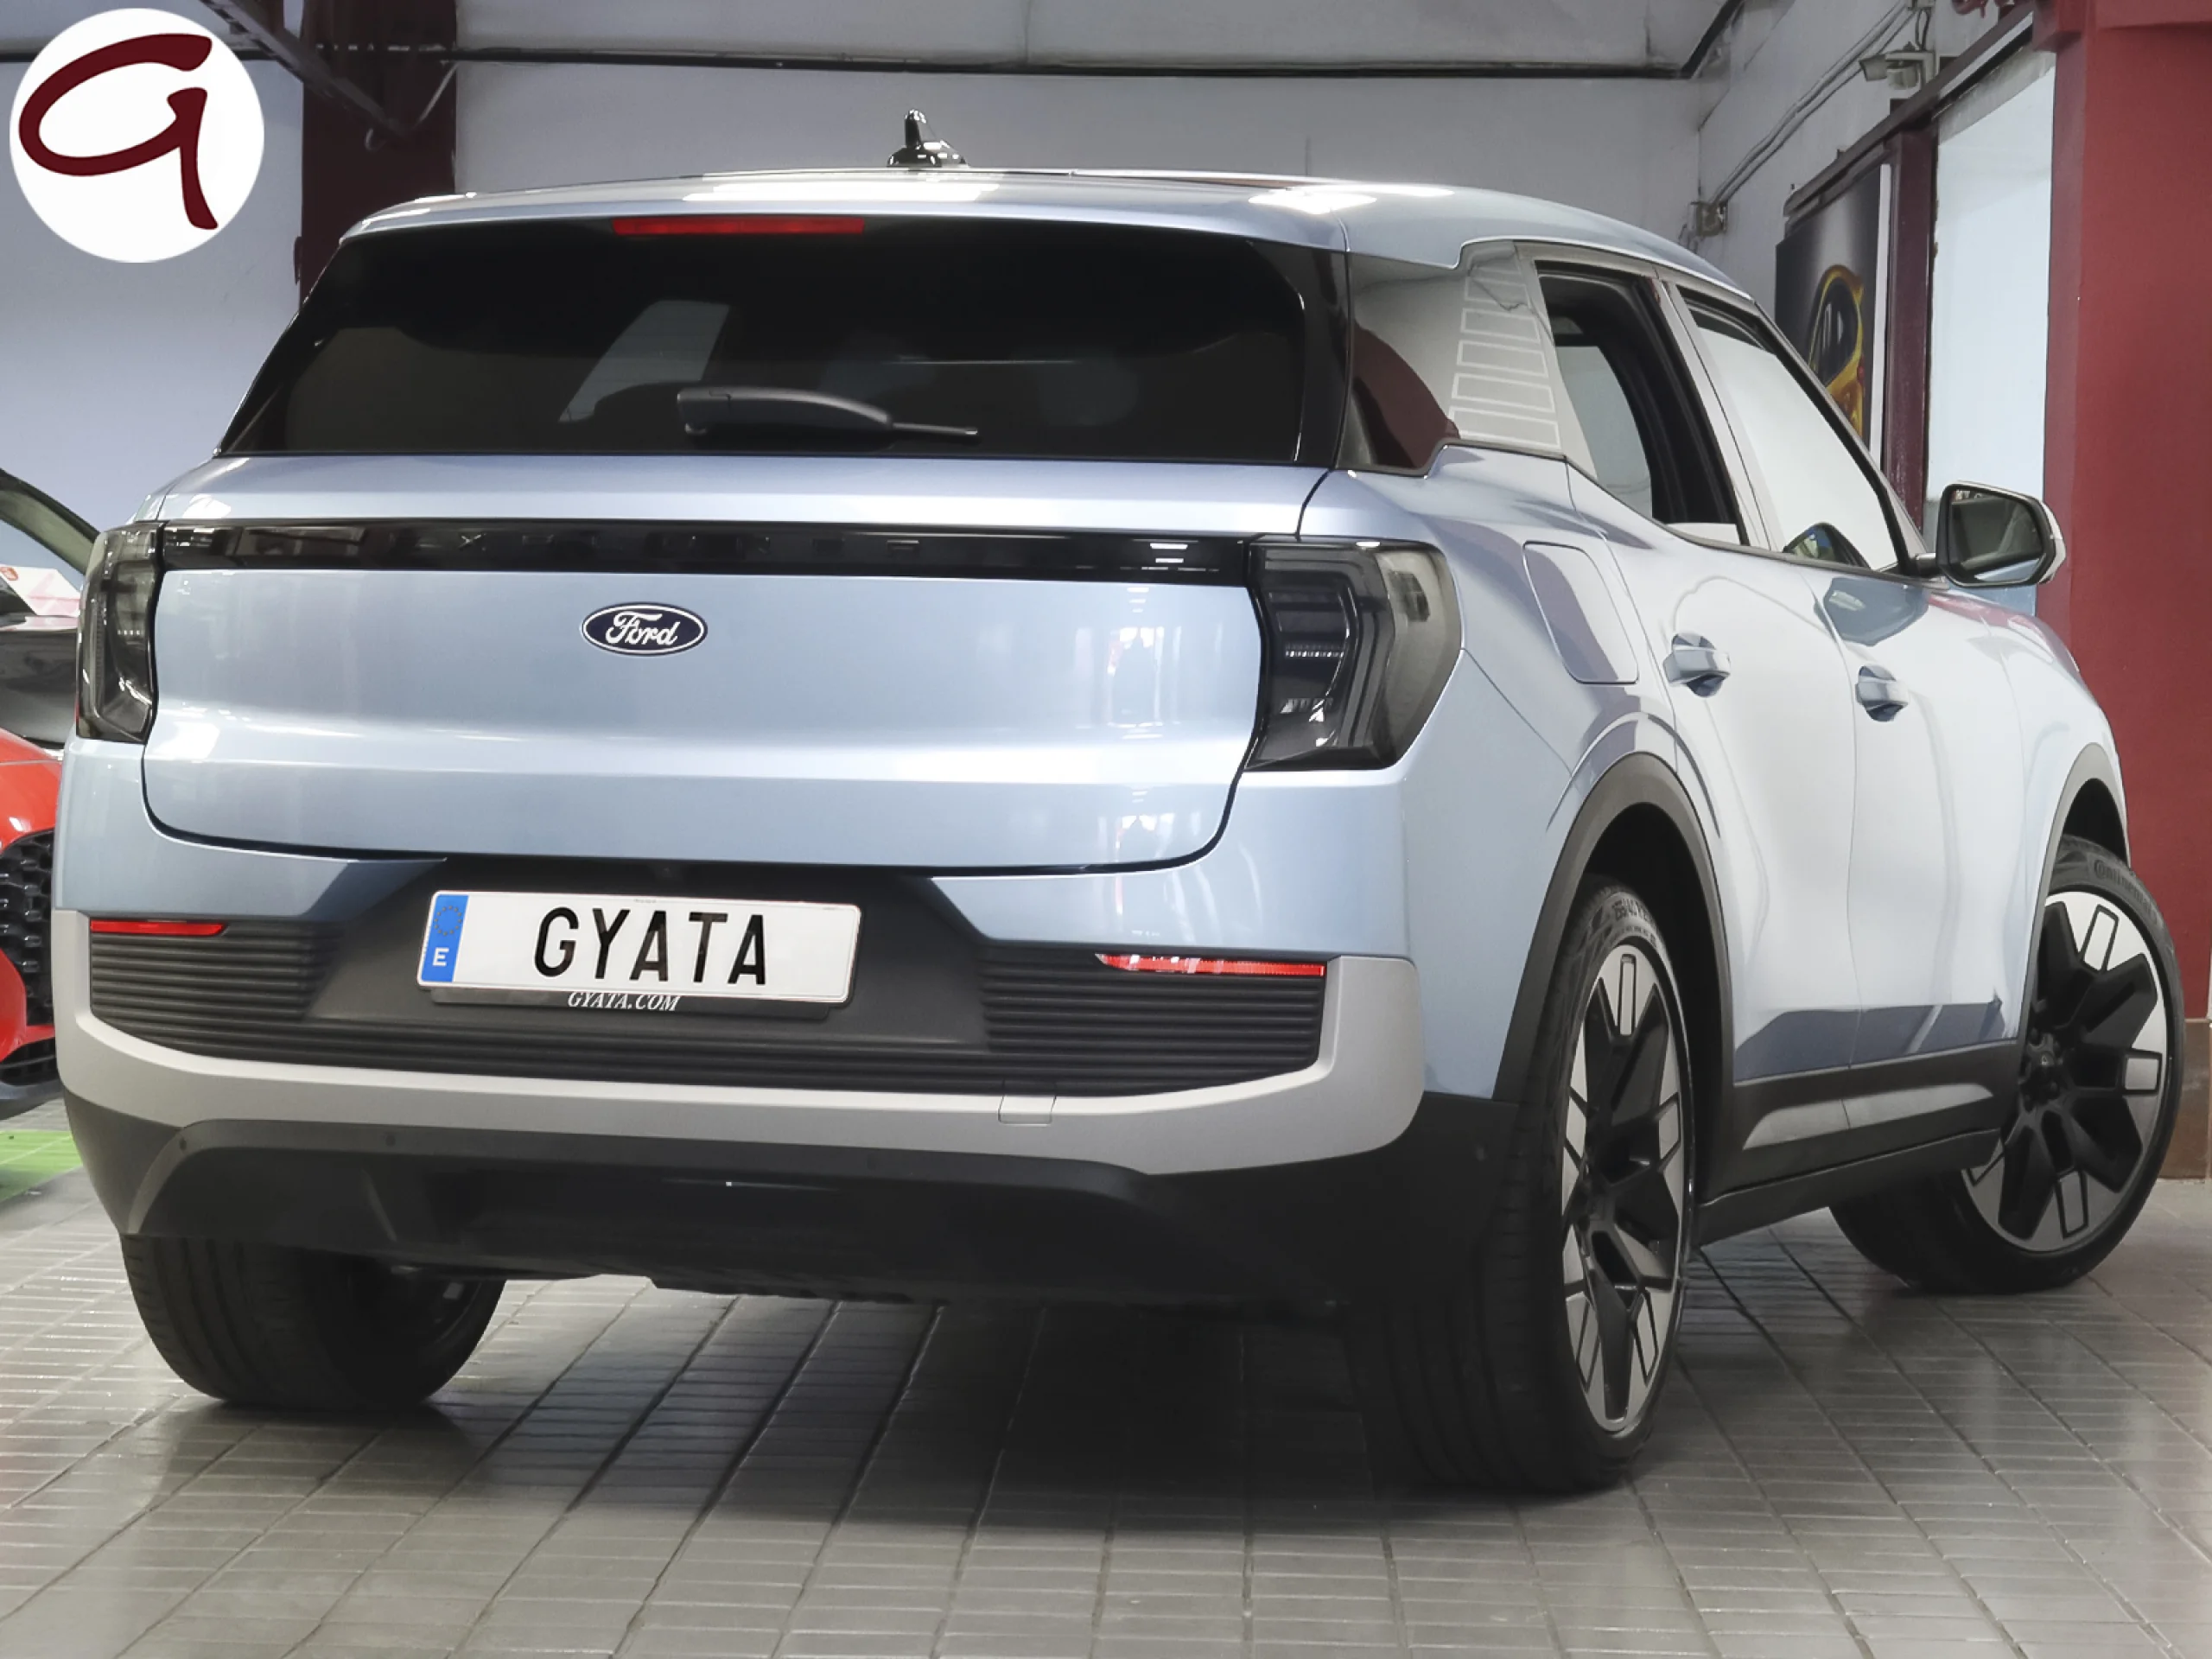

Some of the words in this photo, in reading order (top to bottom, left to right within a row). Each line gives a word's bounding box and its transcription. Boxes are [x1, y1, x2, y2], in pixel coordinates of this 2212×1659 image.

[605, 610, 681, 645] Ford
[432, 947, 449, 966] E
[533, 906, 766, 985] GYATA
[567, 990, 681, 1012] GYATA.COM
